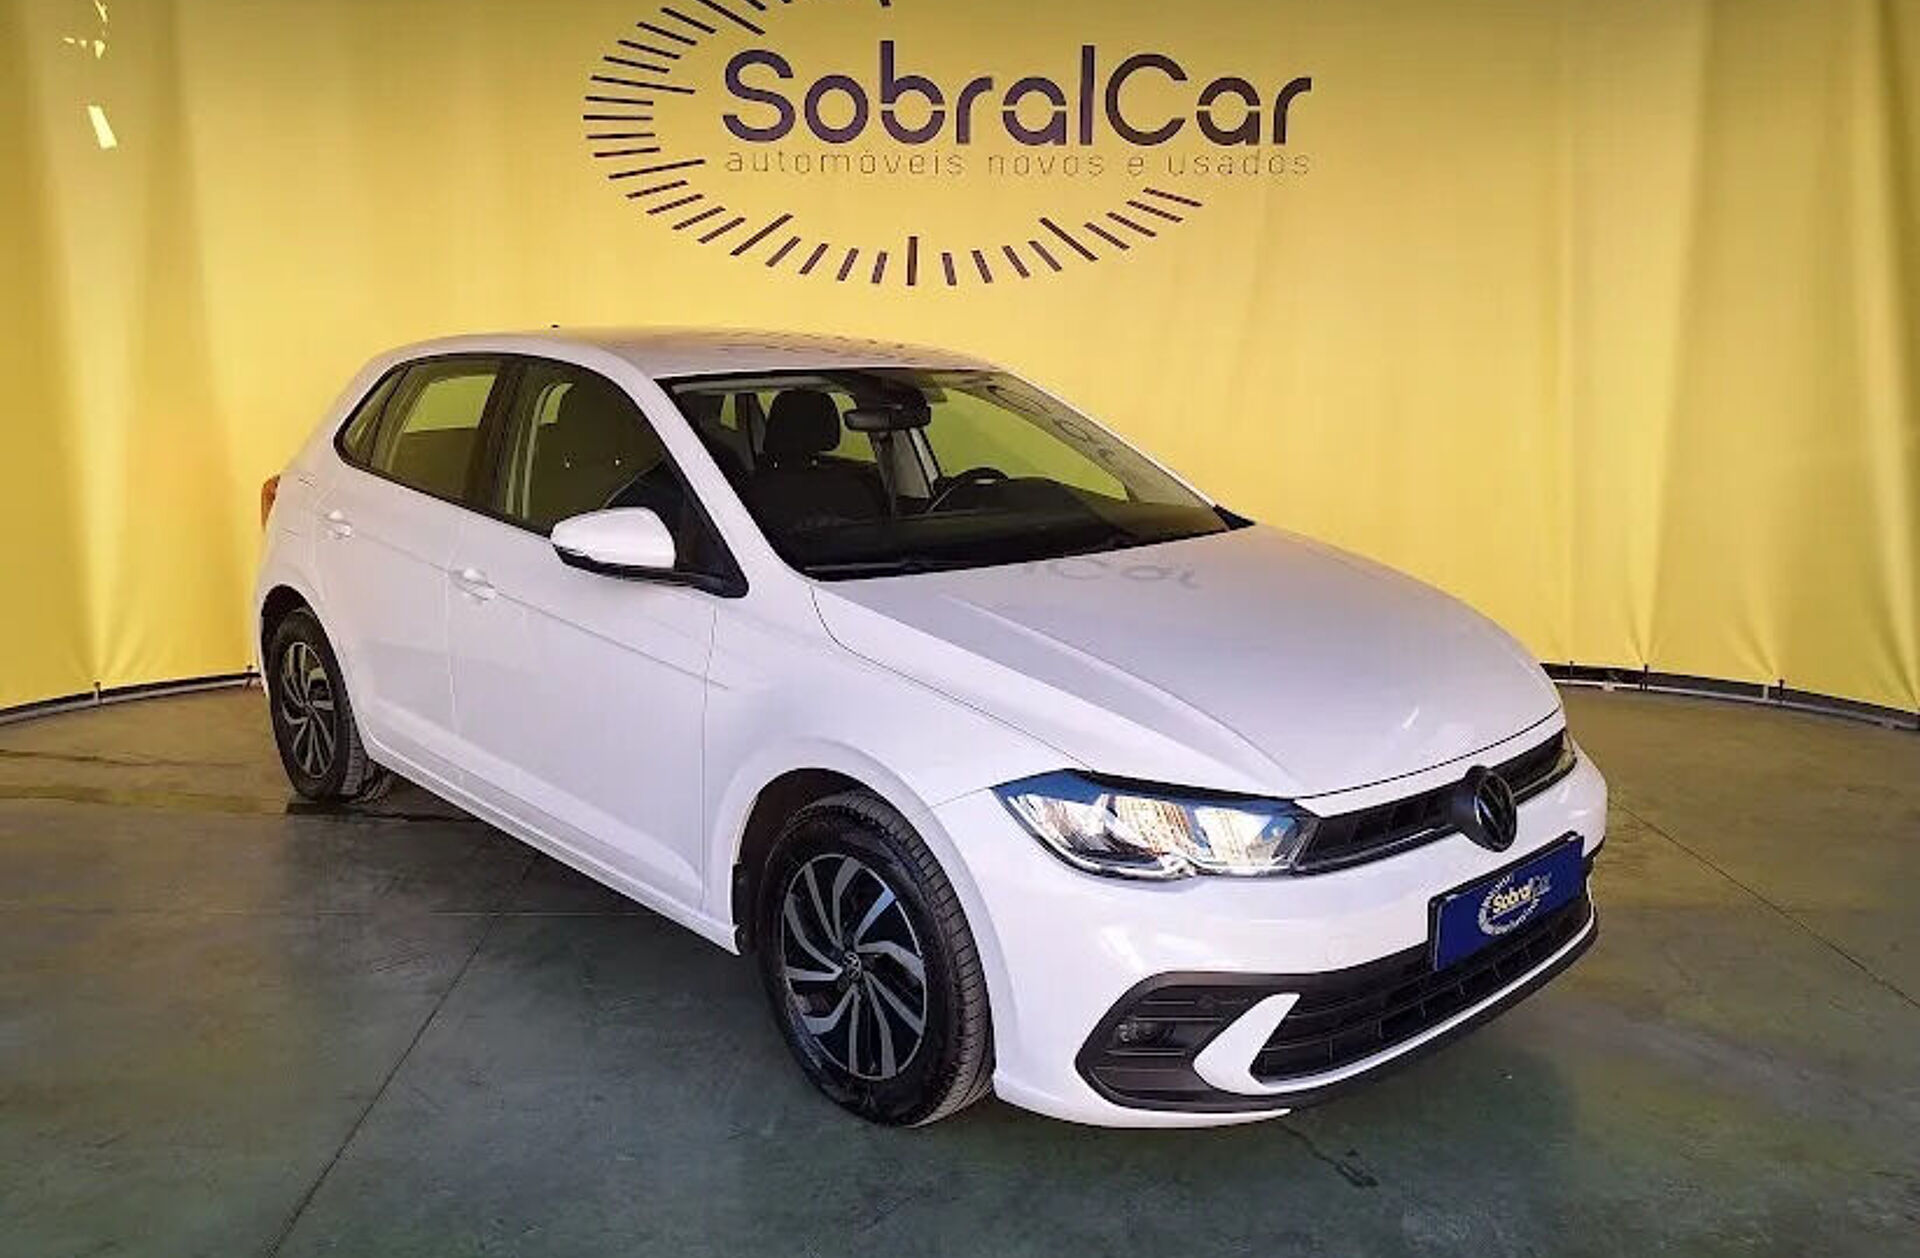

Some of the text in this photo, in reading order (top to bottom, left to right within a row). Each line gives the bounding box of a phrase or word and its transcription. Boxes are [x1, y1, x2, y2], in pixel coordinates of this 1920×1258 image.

[722, 40, 1312, 145] SobralCar
[726, 149, 1312, 176] automóveis novos e usados
